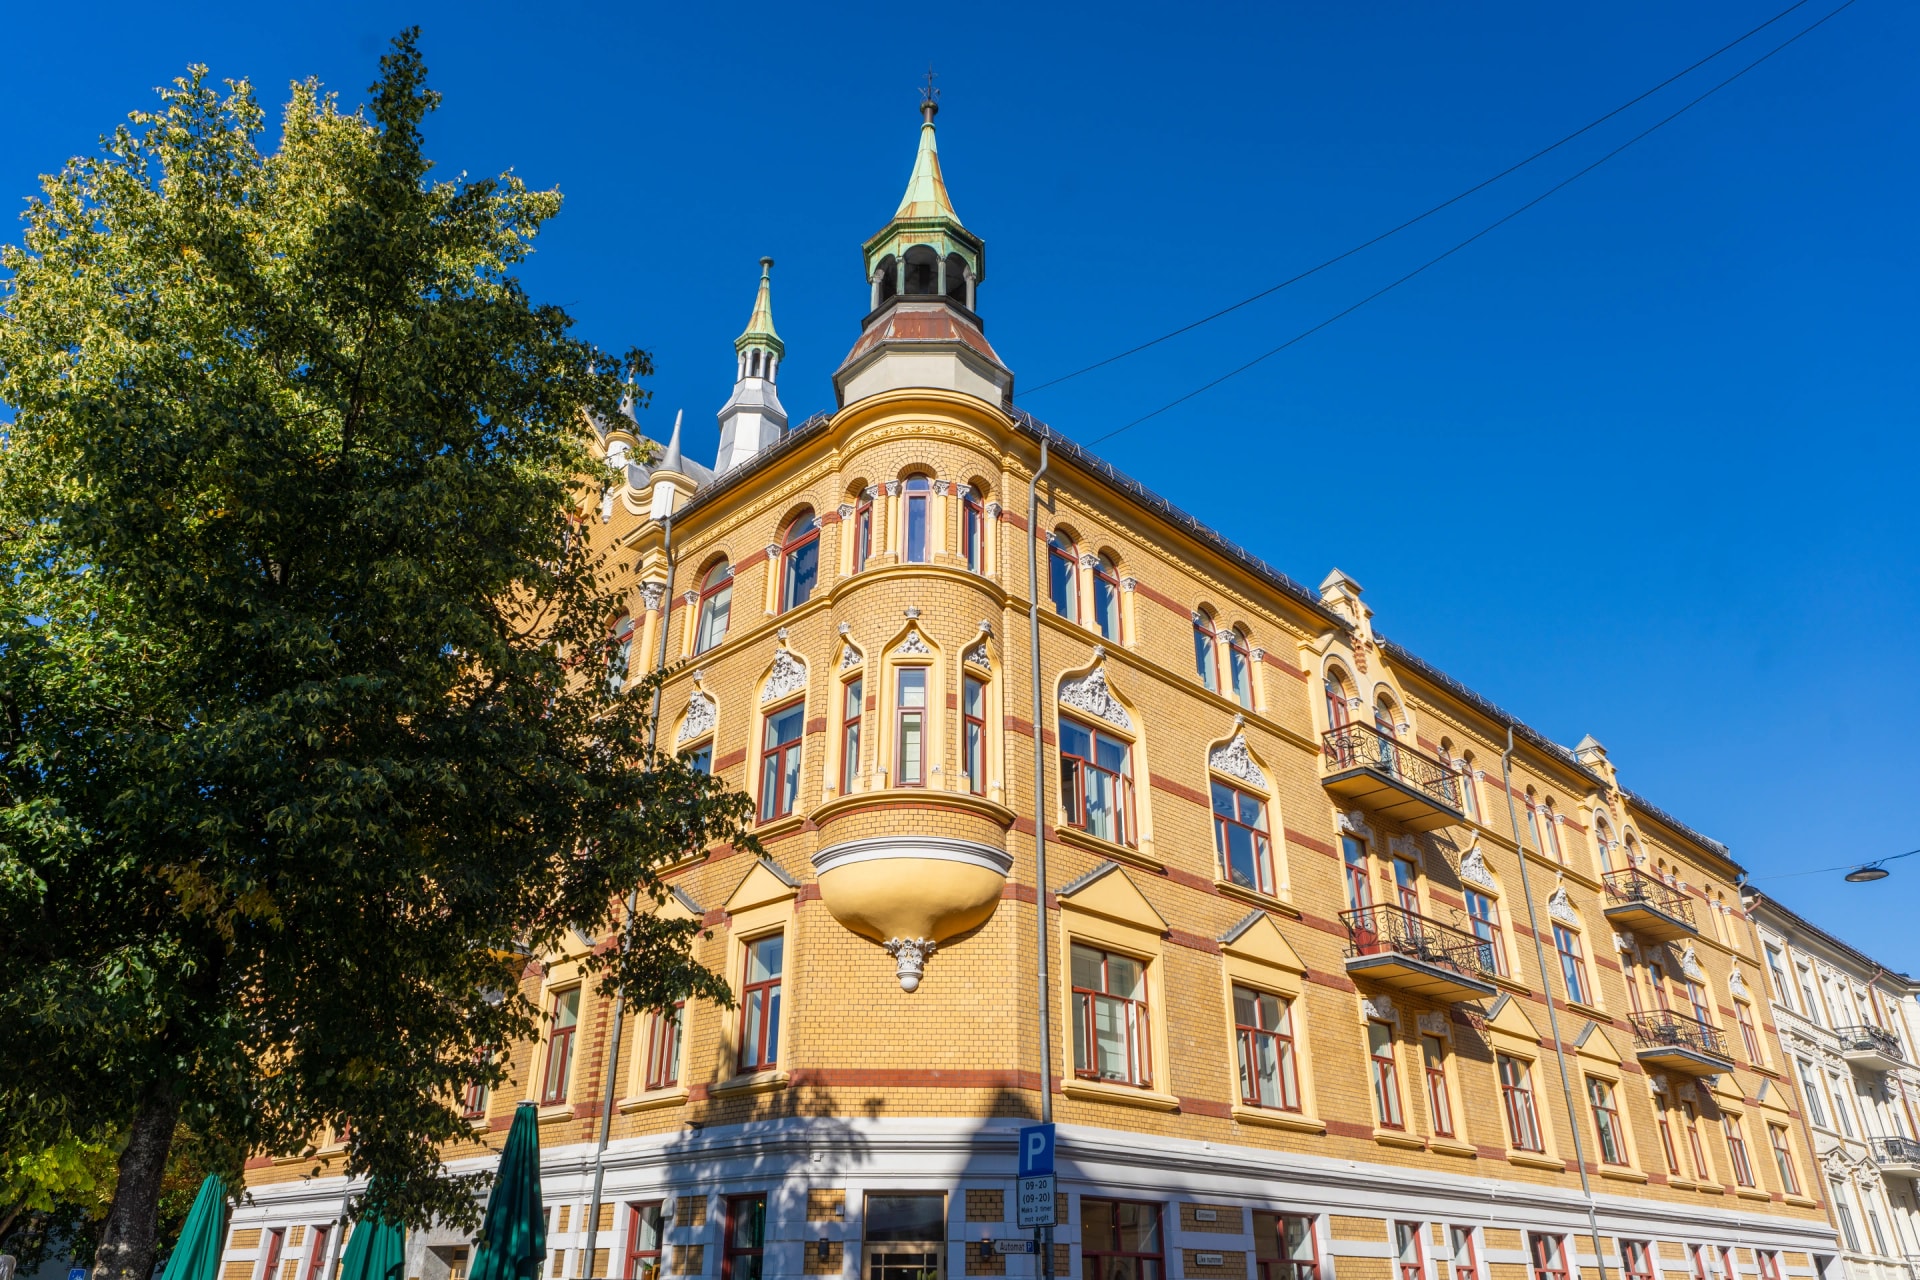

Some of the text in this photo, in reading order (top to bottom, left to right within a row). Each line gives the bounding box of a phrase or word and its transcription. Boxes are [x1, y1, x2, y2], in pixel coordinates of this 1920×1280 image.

[1027, 1132, 1046, 1170] P
[1025, 1180, 1047, 1190] 09-20
[1022, 1192, 1050, 1204] (09-20)
[1000, 1241, 1025, 1251] Automat
